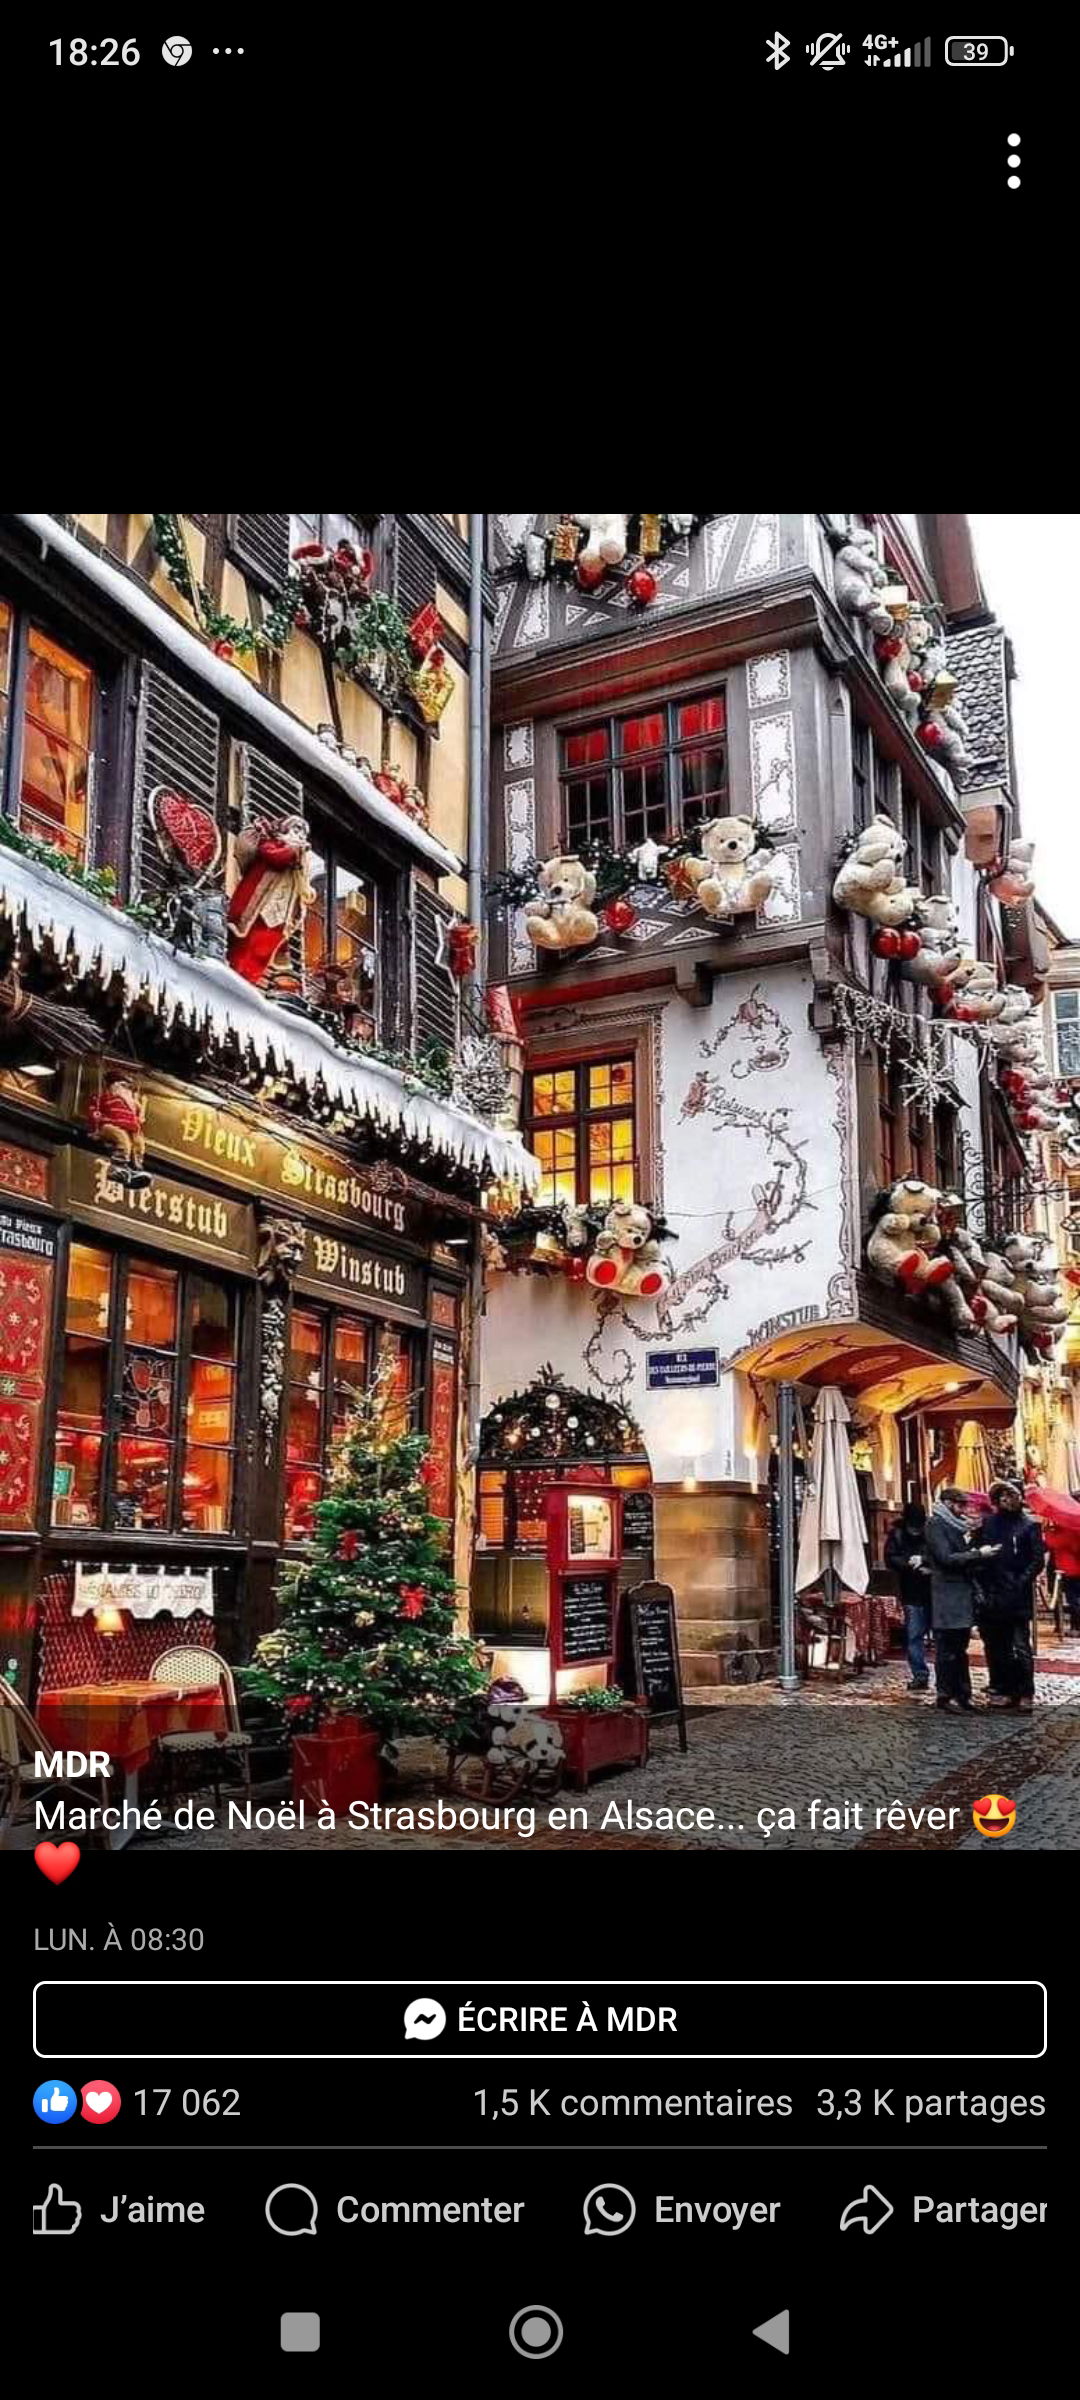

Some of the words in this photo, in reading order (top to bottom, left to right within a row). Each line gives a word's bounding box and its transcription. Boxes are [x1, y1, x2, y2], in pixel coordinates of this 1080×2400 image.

[181, 1107, 256, 1168] Vieux
[281, 1148, 405, 1233] Strasbourg
[314, 1235, 405, 1296] Winstub
